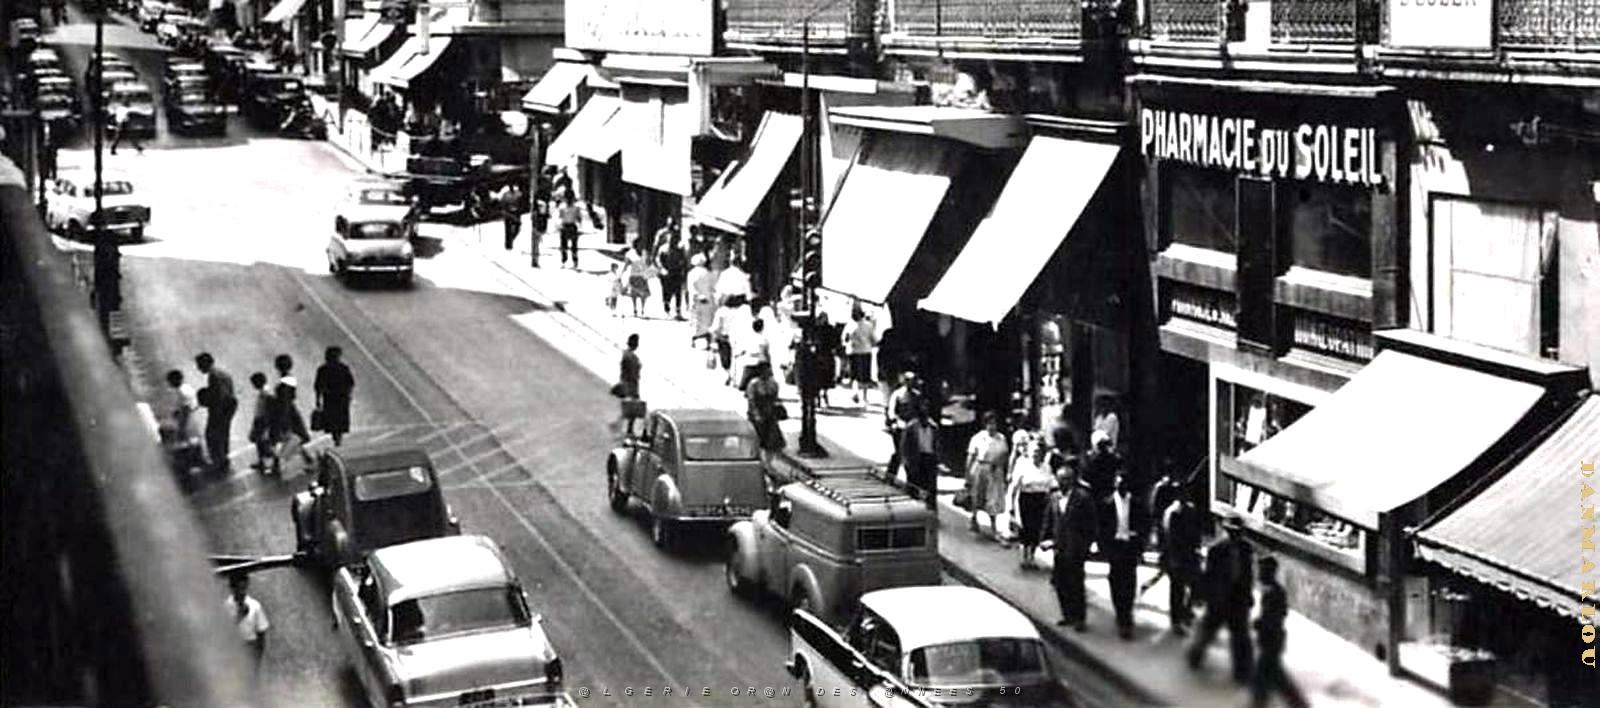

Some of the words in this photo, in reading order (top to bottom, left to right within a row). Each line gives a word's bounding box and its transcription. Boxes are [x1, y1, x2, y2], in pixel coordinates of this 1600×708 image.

[1141, 108, 1256, 170] PHARMACIE
[1261, 129, 1289, 177] DU
[1295, 123, 1382, 187] SOLEIL
